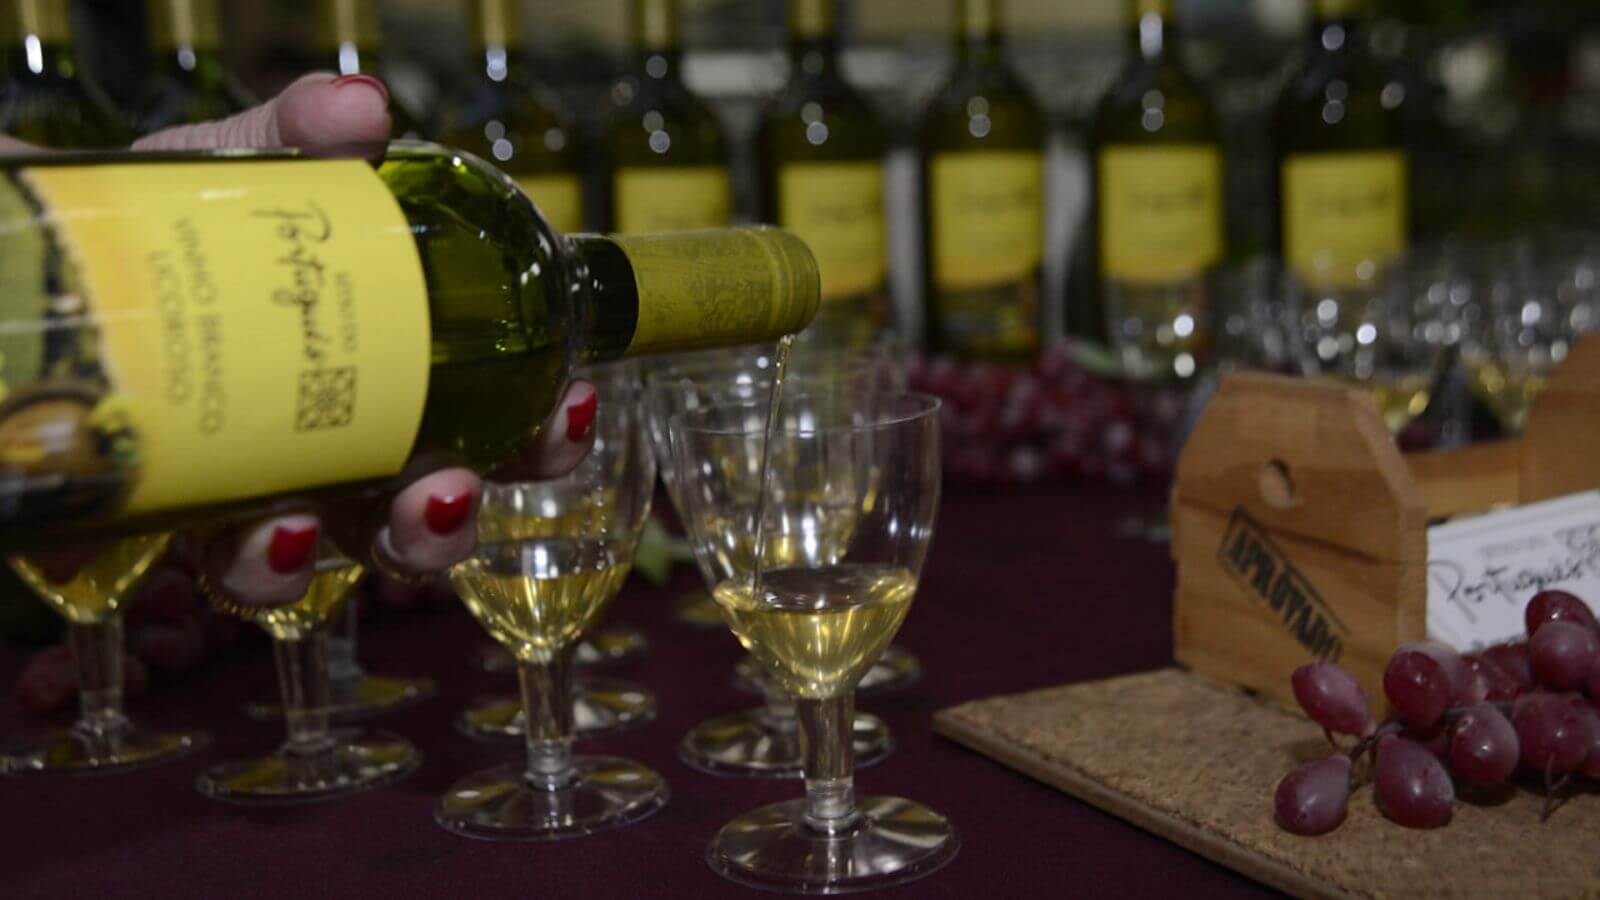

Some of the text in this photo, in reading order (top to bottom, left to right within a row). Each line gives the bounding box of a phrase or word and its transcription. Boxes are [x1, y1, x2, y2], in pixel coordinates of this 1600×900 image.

[147, 251, 193, 407] LICOROSO
[172, 217, 227, 436] VINHO BRANCO
